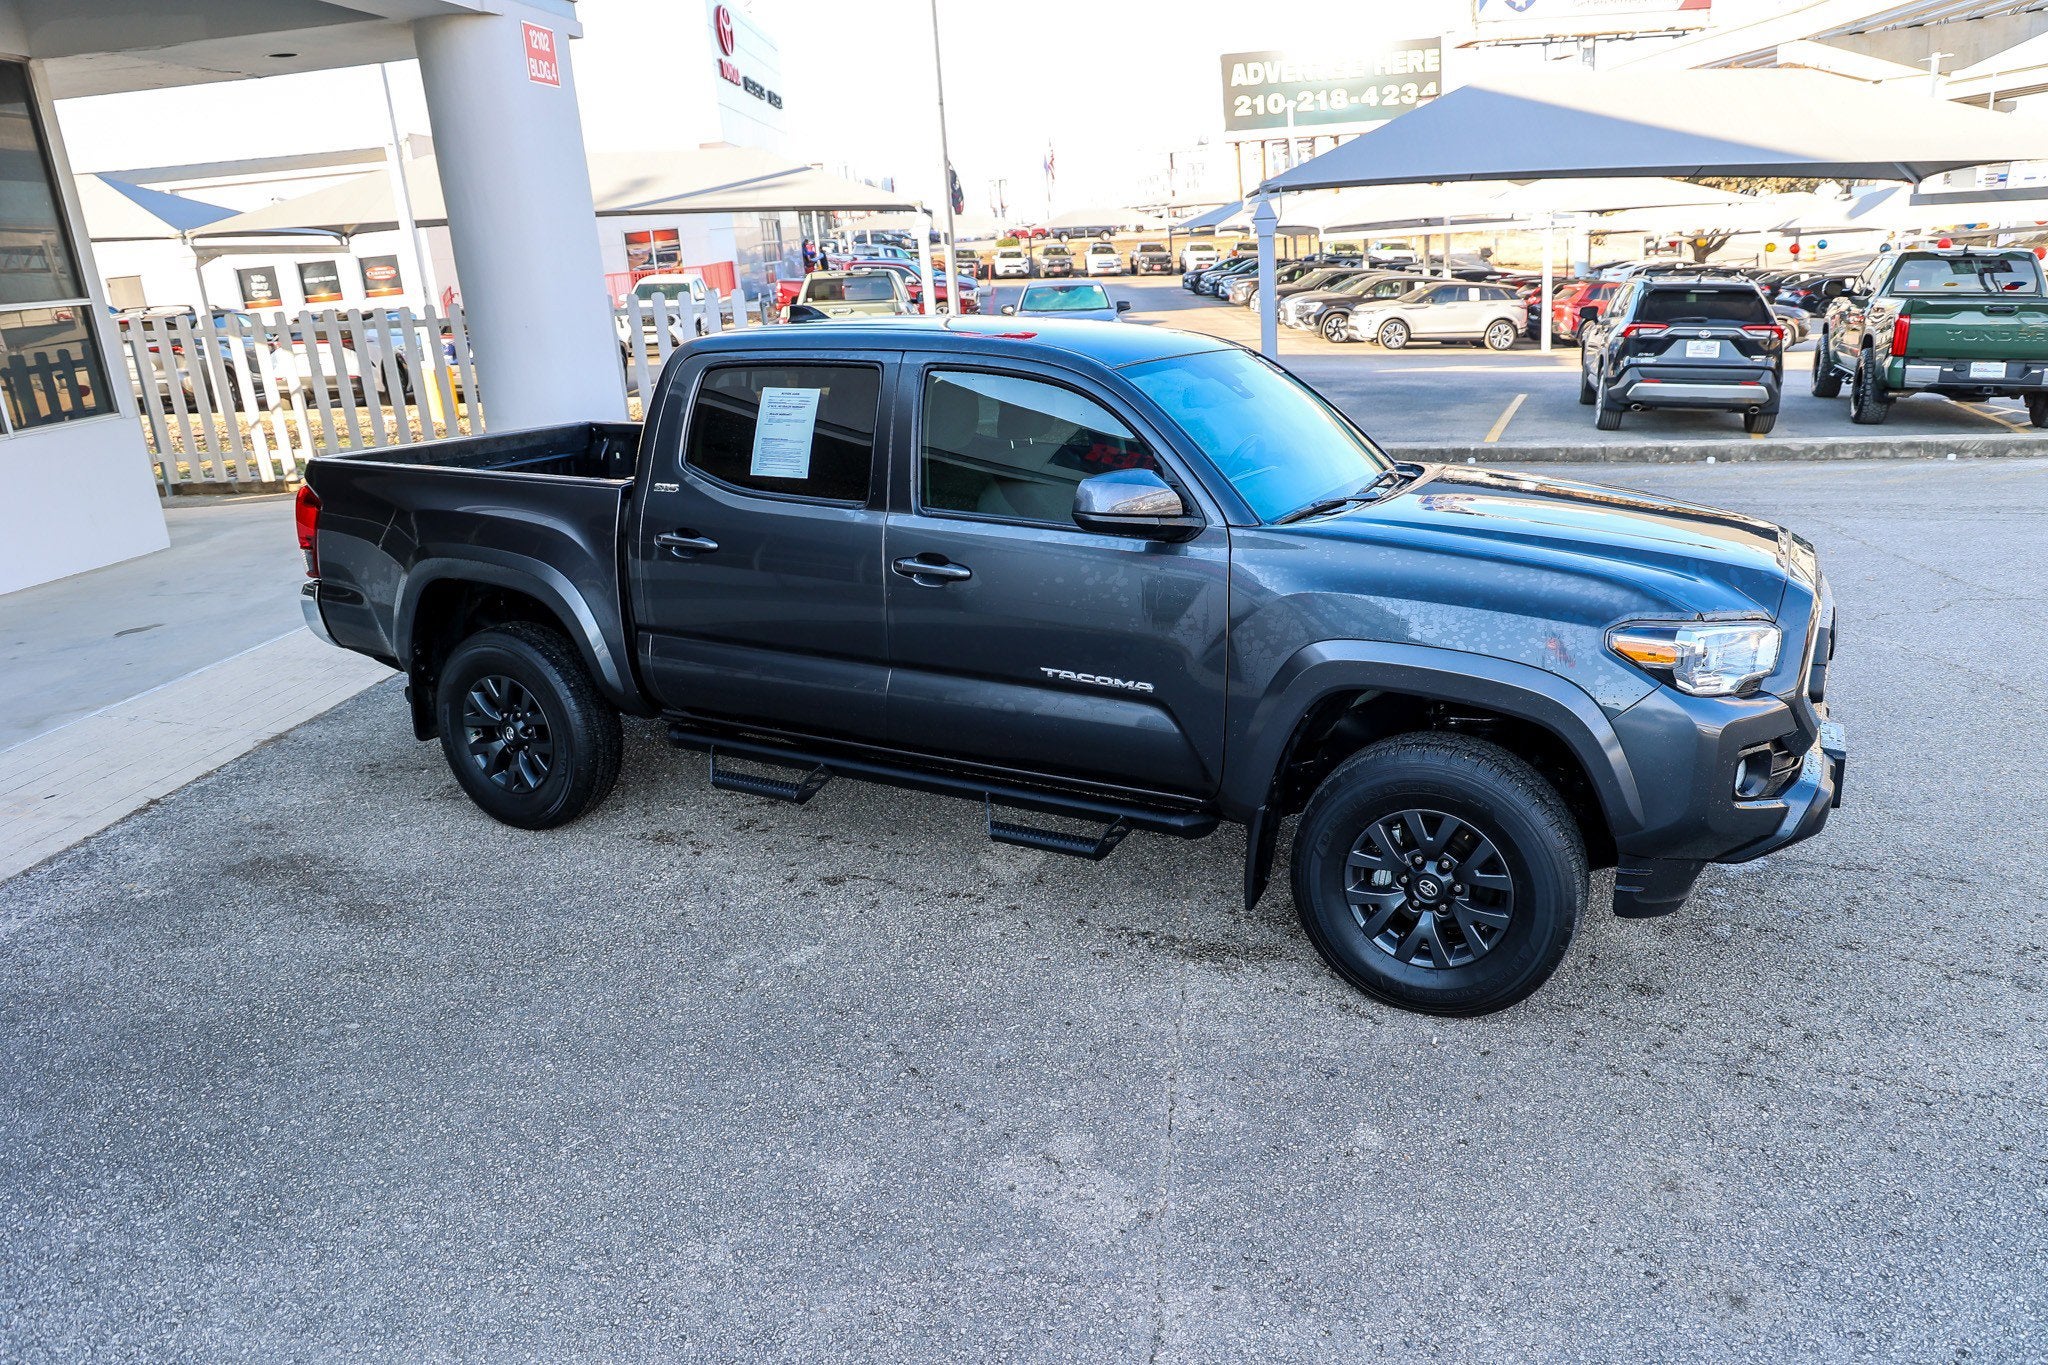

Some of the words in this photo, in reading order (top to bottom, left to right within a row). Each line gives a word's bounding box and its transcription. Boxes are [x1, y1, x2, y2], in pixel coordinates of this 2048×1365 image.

[1374, 48, 1440, 76] HERE
[1234, 81, 1438, 117] 210218-4234
[1040, 667, 1155, 693] TACOMA
